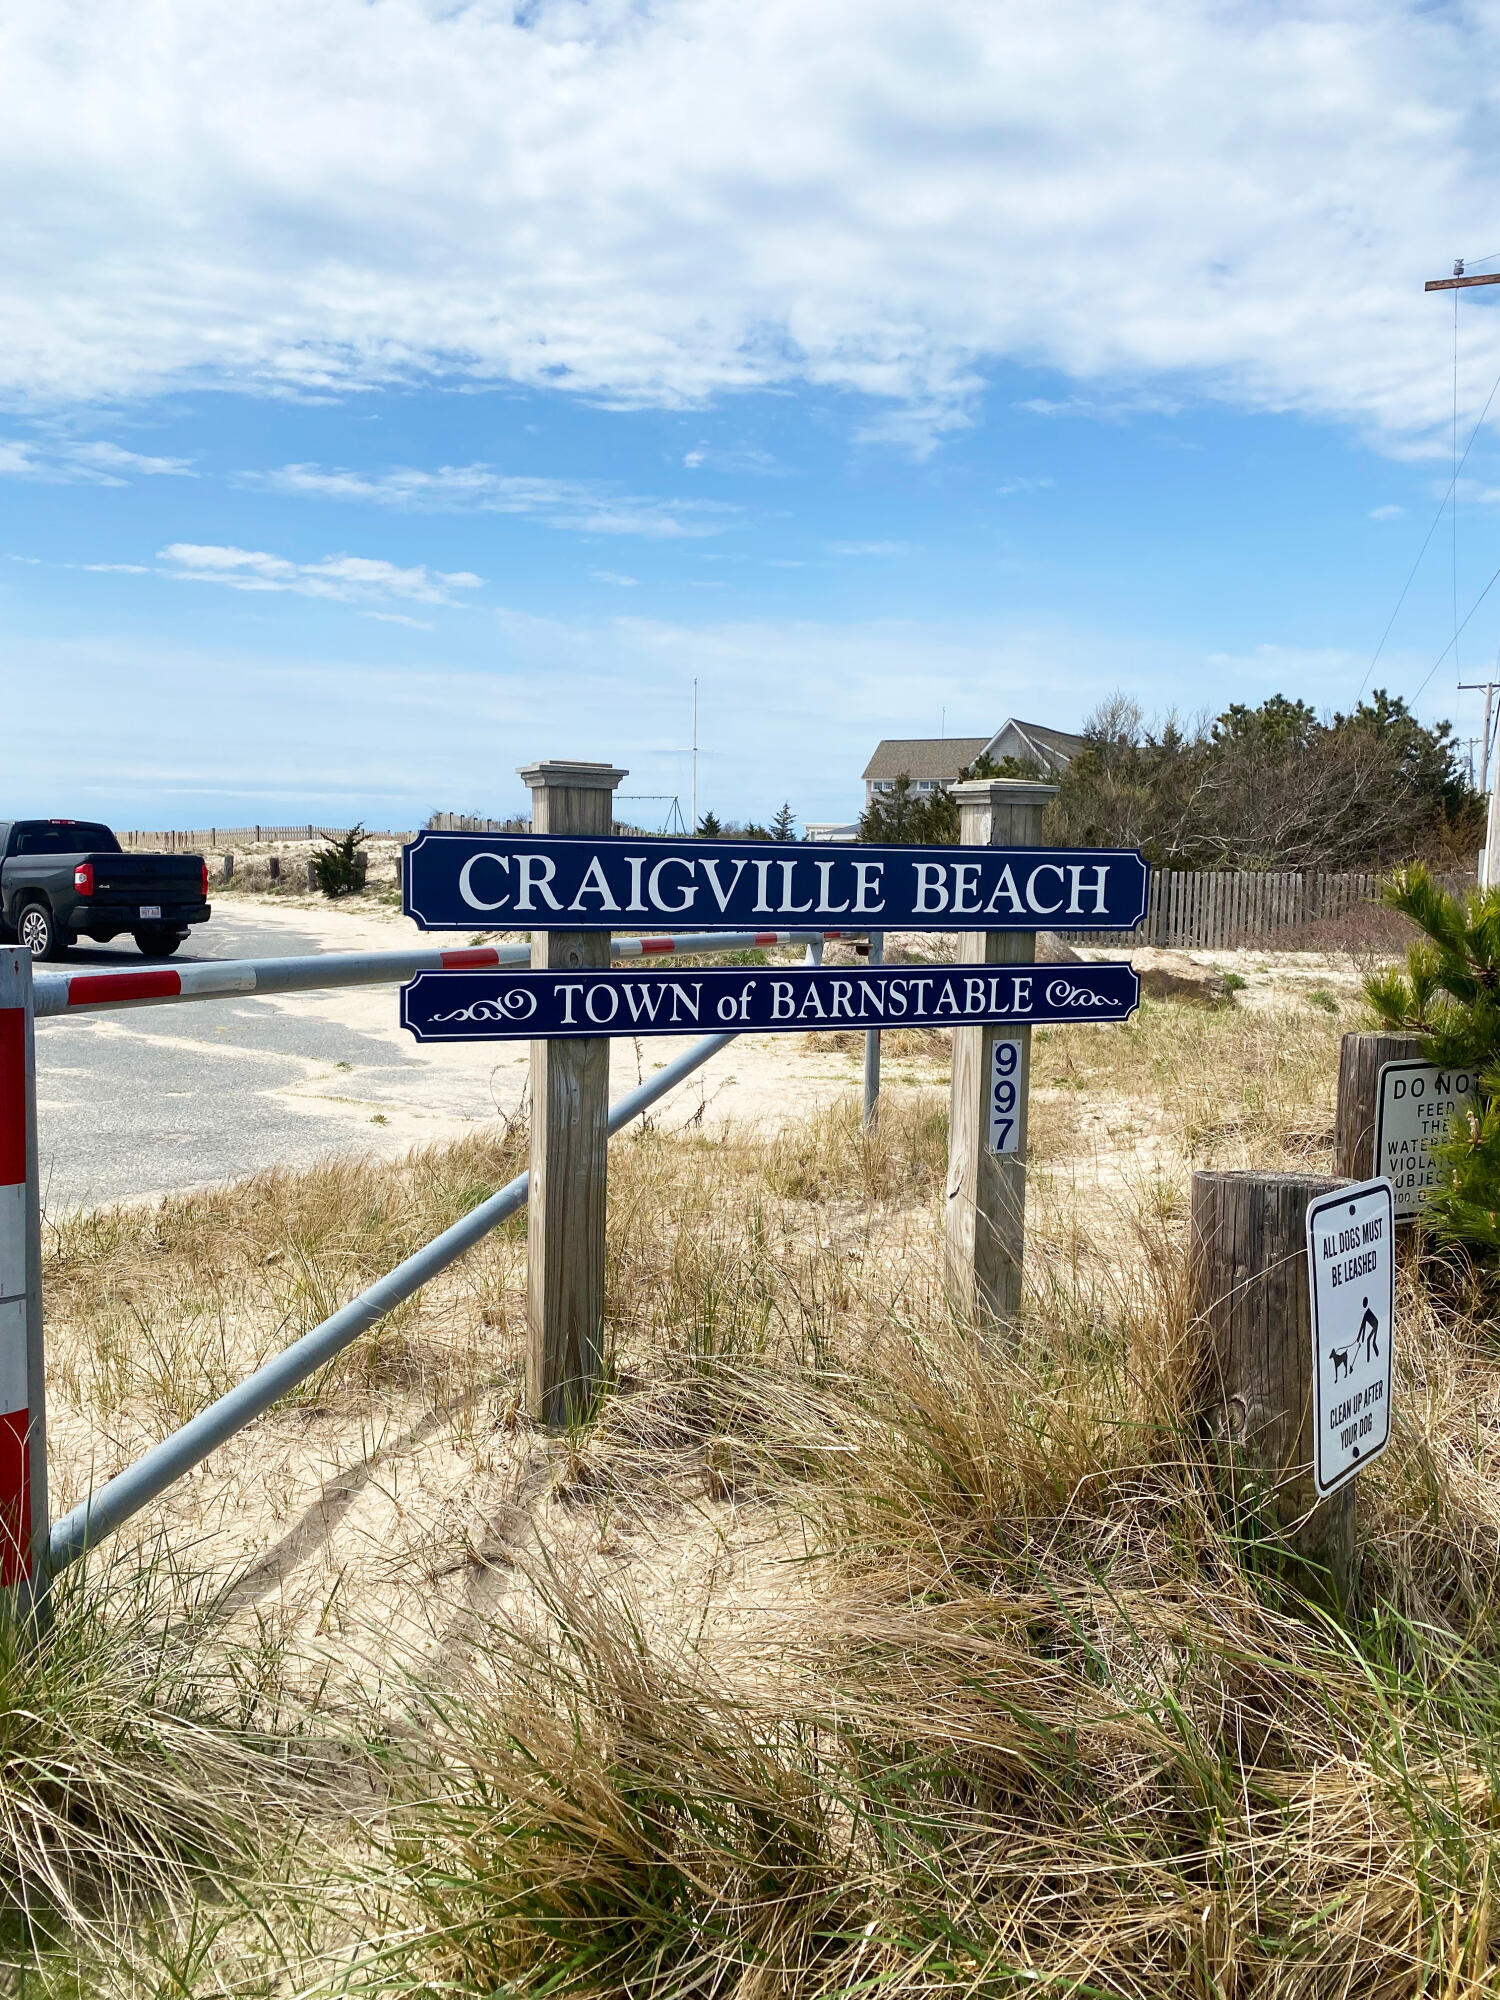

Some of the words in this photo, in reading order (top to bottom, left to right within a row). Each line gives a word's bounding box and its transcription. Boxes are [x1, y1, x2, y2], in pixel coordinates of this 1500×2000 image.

[459, 852, 886, 912] CRAIGVILLE
[911, 863, 1110, 914] BEACH
[554, 983, 703, 1024] TOWN
[717, 981, 756, 1020] of
[770, 977, 1033, 1019] BARNSTABLE
[994, 1043, 1017, 1150] 997
[1394, 1078, 1424, 1099] DO
[1418, 1101, 1455, 1117] FEED
[1422, 1119, 1450, 1134] THE
[1323, 1236, 1338, 1260] ALL
[1339, 1226, 1360, 1253] DOGS
[1362, 1218, 1382, 1244] MUST
[1332, 1264, 1342, 1287] BE
[1344, 1250, 1377, 1282] LEASHED
[1330, 1398, 1351, 1429] CLEAN
[1353, 1392, 1362, 1414] UP
[1363, 1380, 1383, 1408] AFTER
[1341, 1422, 1357, 1450] YOUR
[1360, 1412, 1372, 1438] DOG
